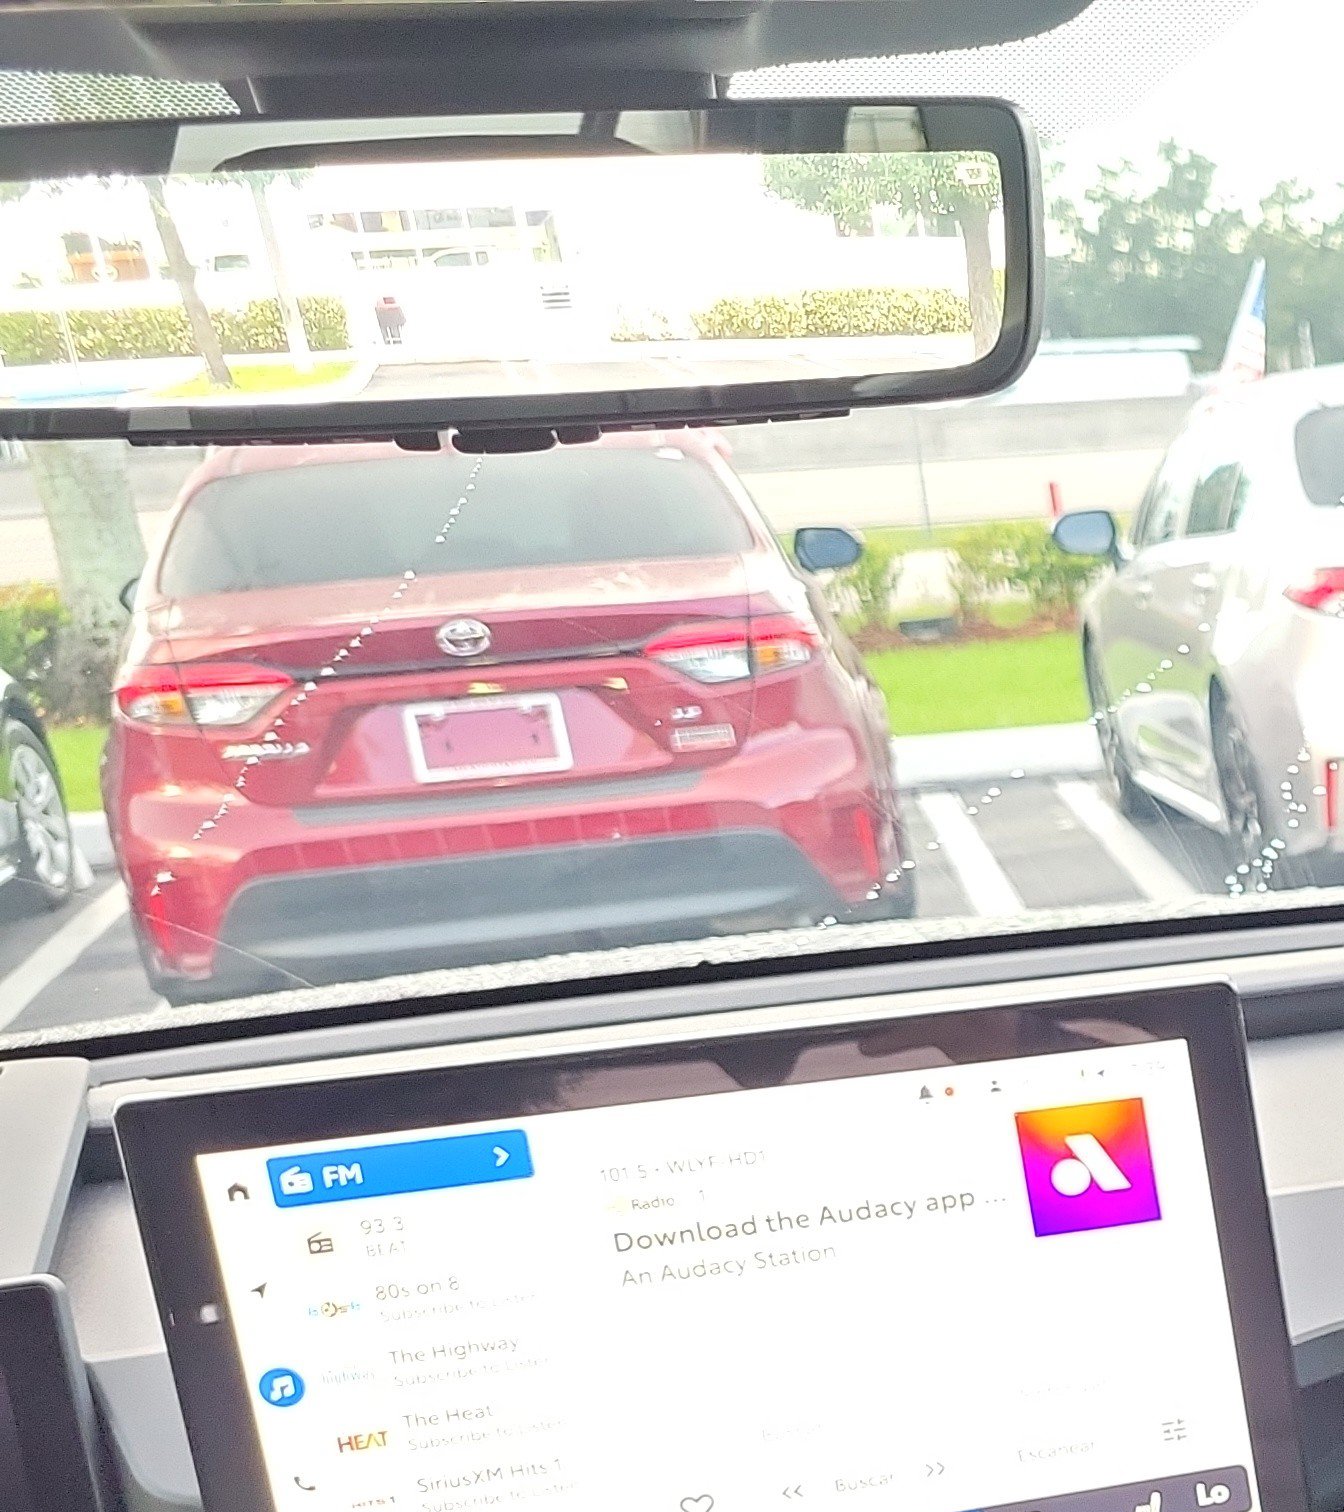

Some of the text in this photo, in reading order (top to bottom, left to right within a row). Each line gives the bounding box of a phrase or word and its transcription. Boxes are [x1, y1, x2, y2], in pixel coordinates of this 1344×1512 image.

[322, 1163, 364, 1189] FM
[613, 1214, 758, 1253] Download
[765, 1210, 810, 1233] the
[819, 1199, 916, 1227] Audacy
[926, 1192, 975, 1214] app
[621, 1246, 837, 1288] An Audacy Station
[375, 1275, 460, 1301] 80s on 8
[389, 1336, 520, 1366] The Highway
[402, 1404, 494, 1430] The Heat
[416, 1466, 503, 1493] SiriusXM
